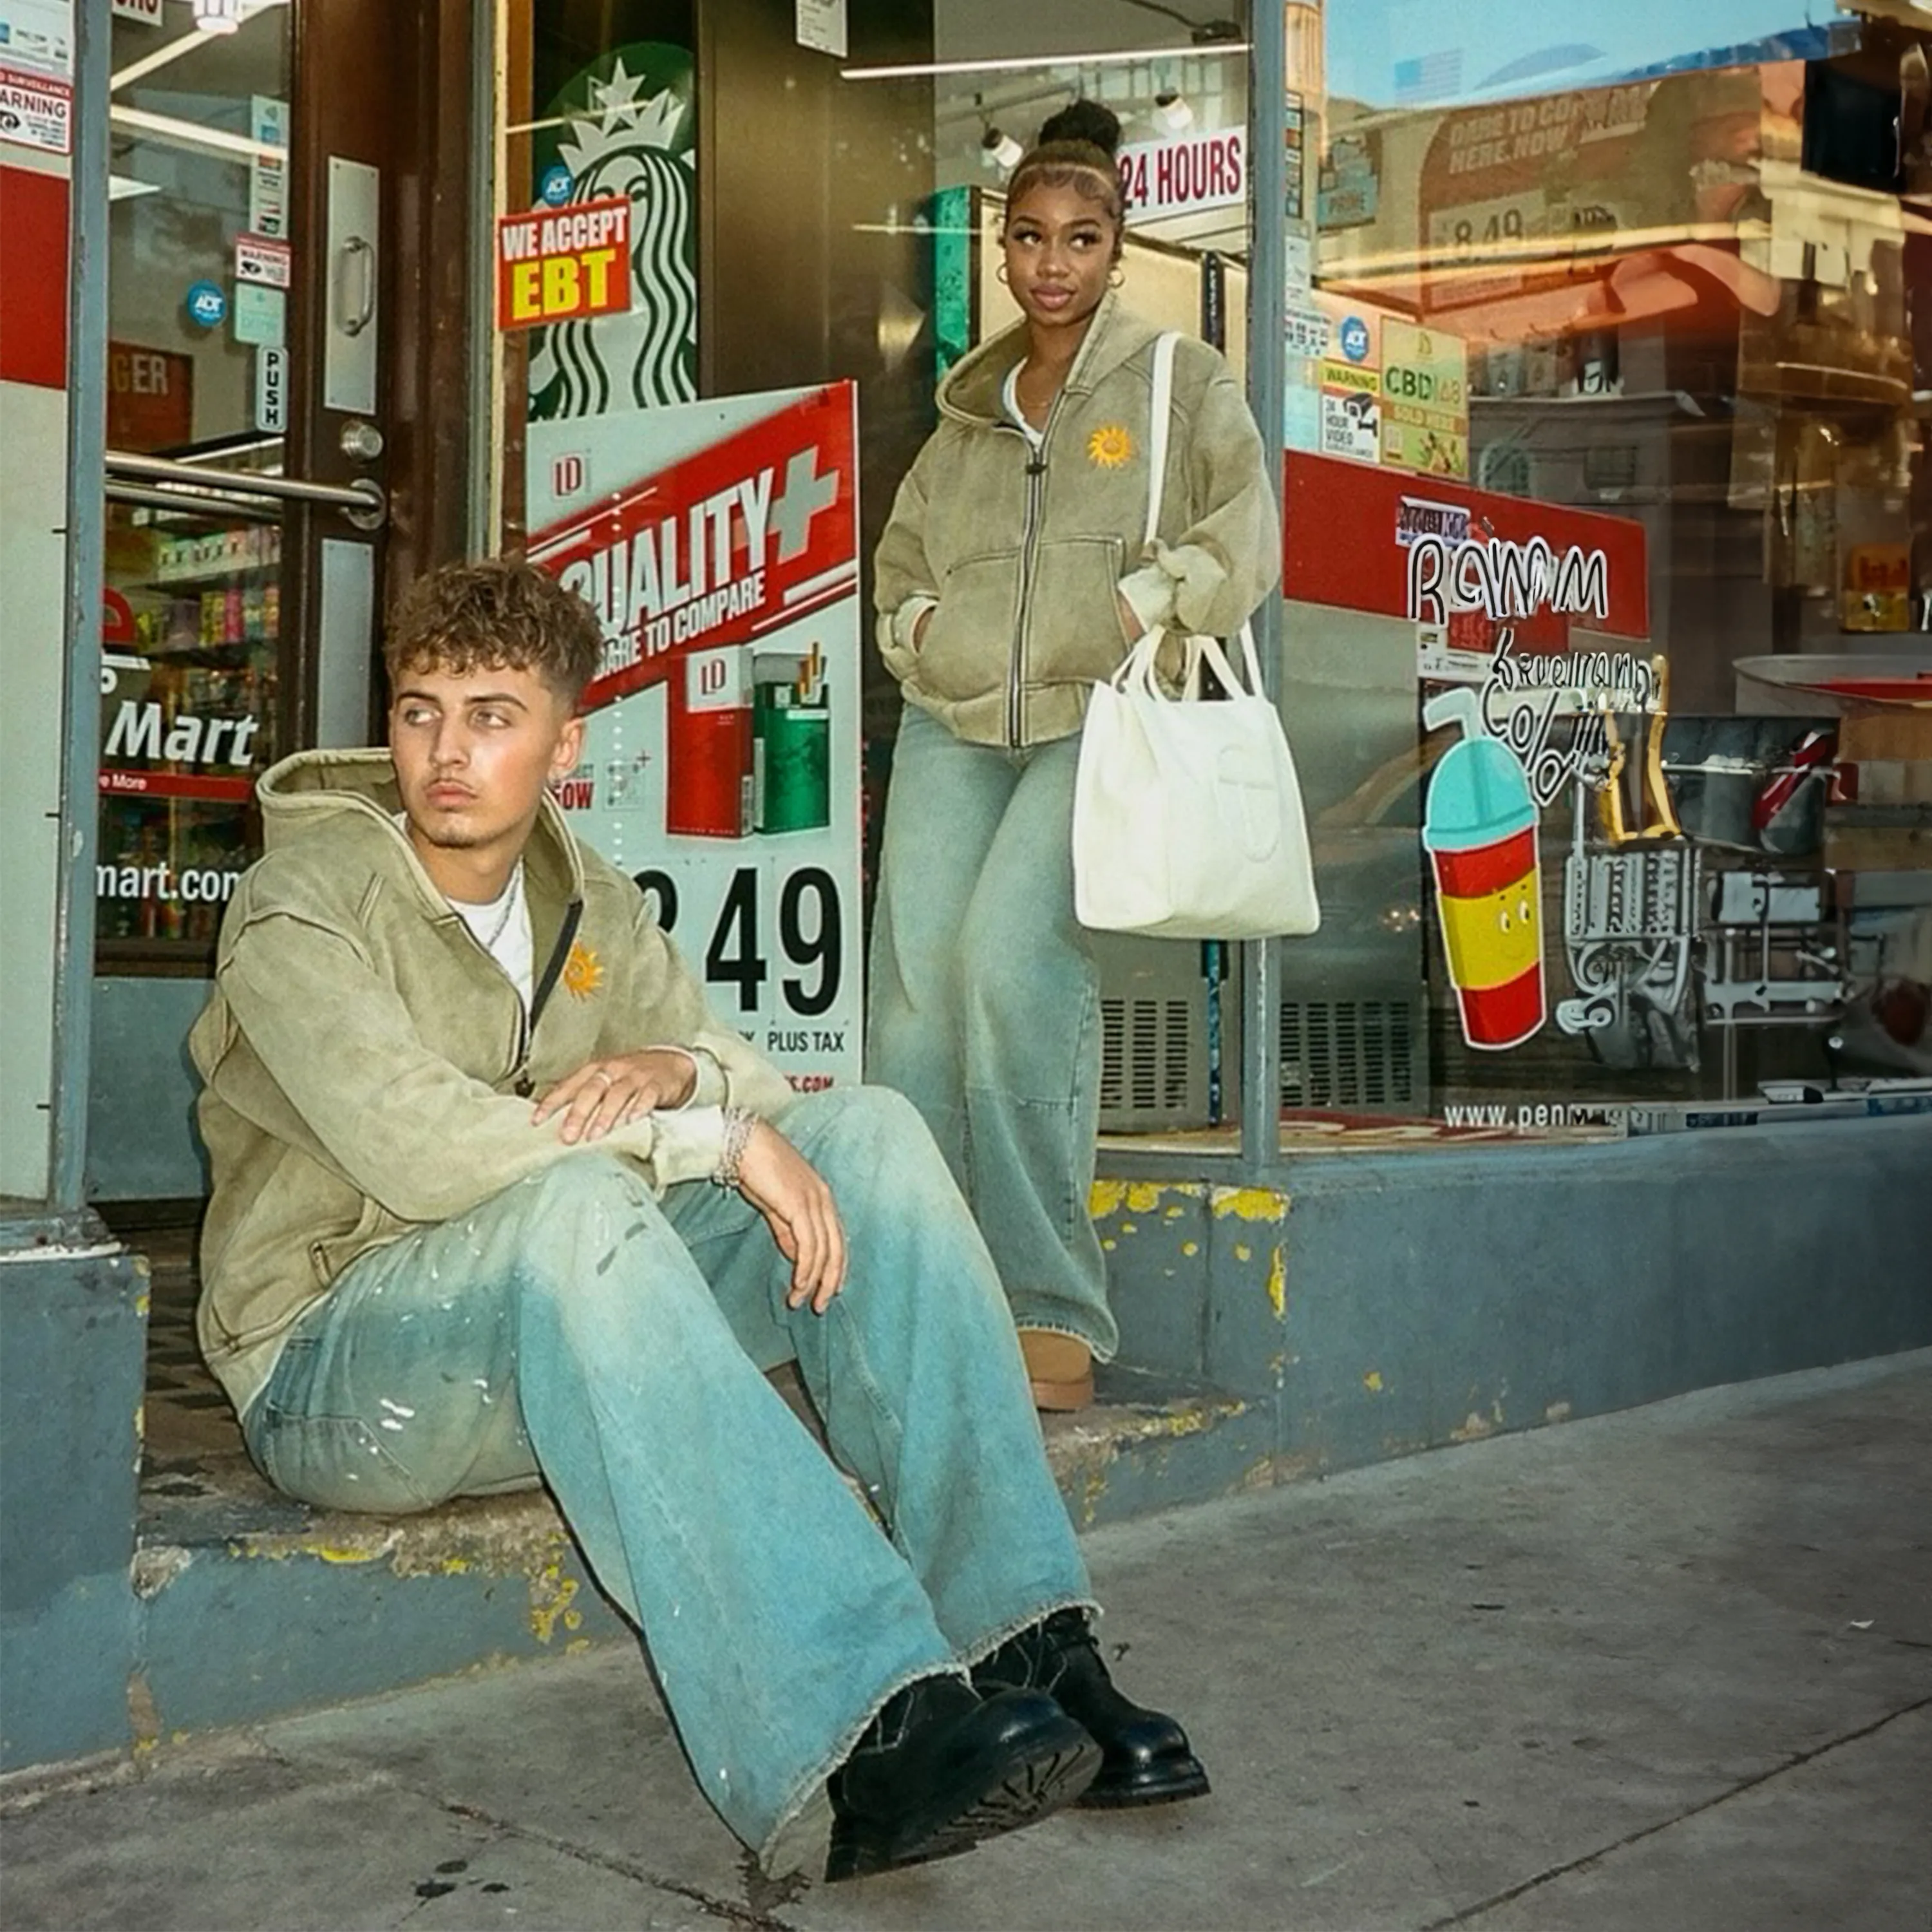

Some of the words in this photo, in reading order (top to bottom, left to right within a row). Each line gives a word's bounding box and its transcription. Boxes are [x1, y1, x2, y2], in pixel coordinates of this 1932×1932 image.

[1119, 153, 1148, 208] 24
[1157, 136, 1241, 205] HOURS
[502, 222, 538, 261] WE
[541, 206, 627, 254] ACCEPT
[513, 249, 616, 321] EBT
[265, 352, 279, 426] PUSH
[1386, 366, 1432, 400] CBD
[559, 468, 773, 636] QUALITY
[645, 616, 670, 658] TO
[674, 569, 766, 645] COMPARE
[104, 700, 259, 765] Mart
[112, 774, 147, 791] More
[768, 1032, 808, 1052] PLUS
[812, 1031, 844, 1052] TAX
